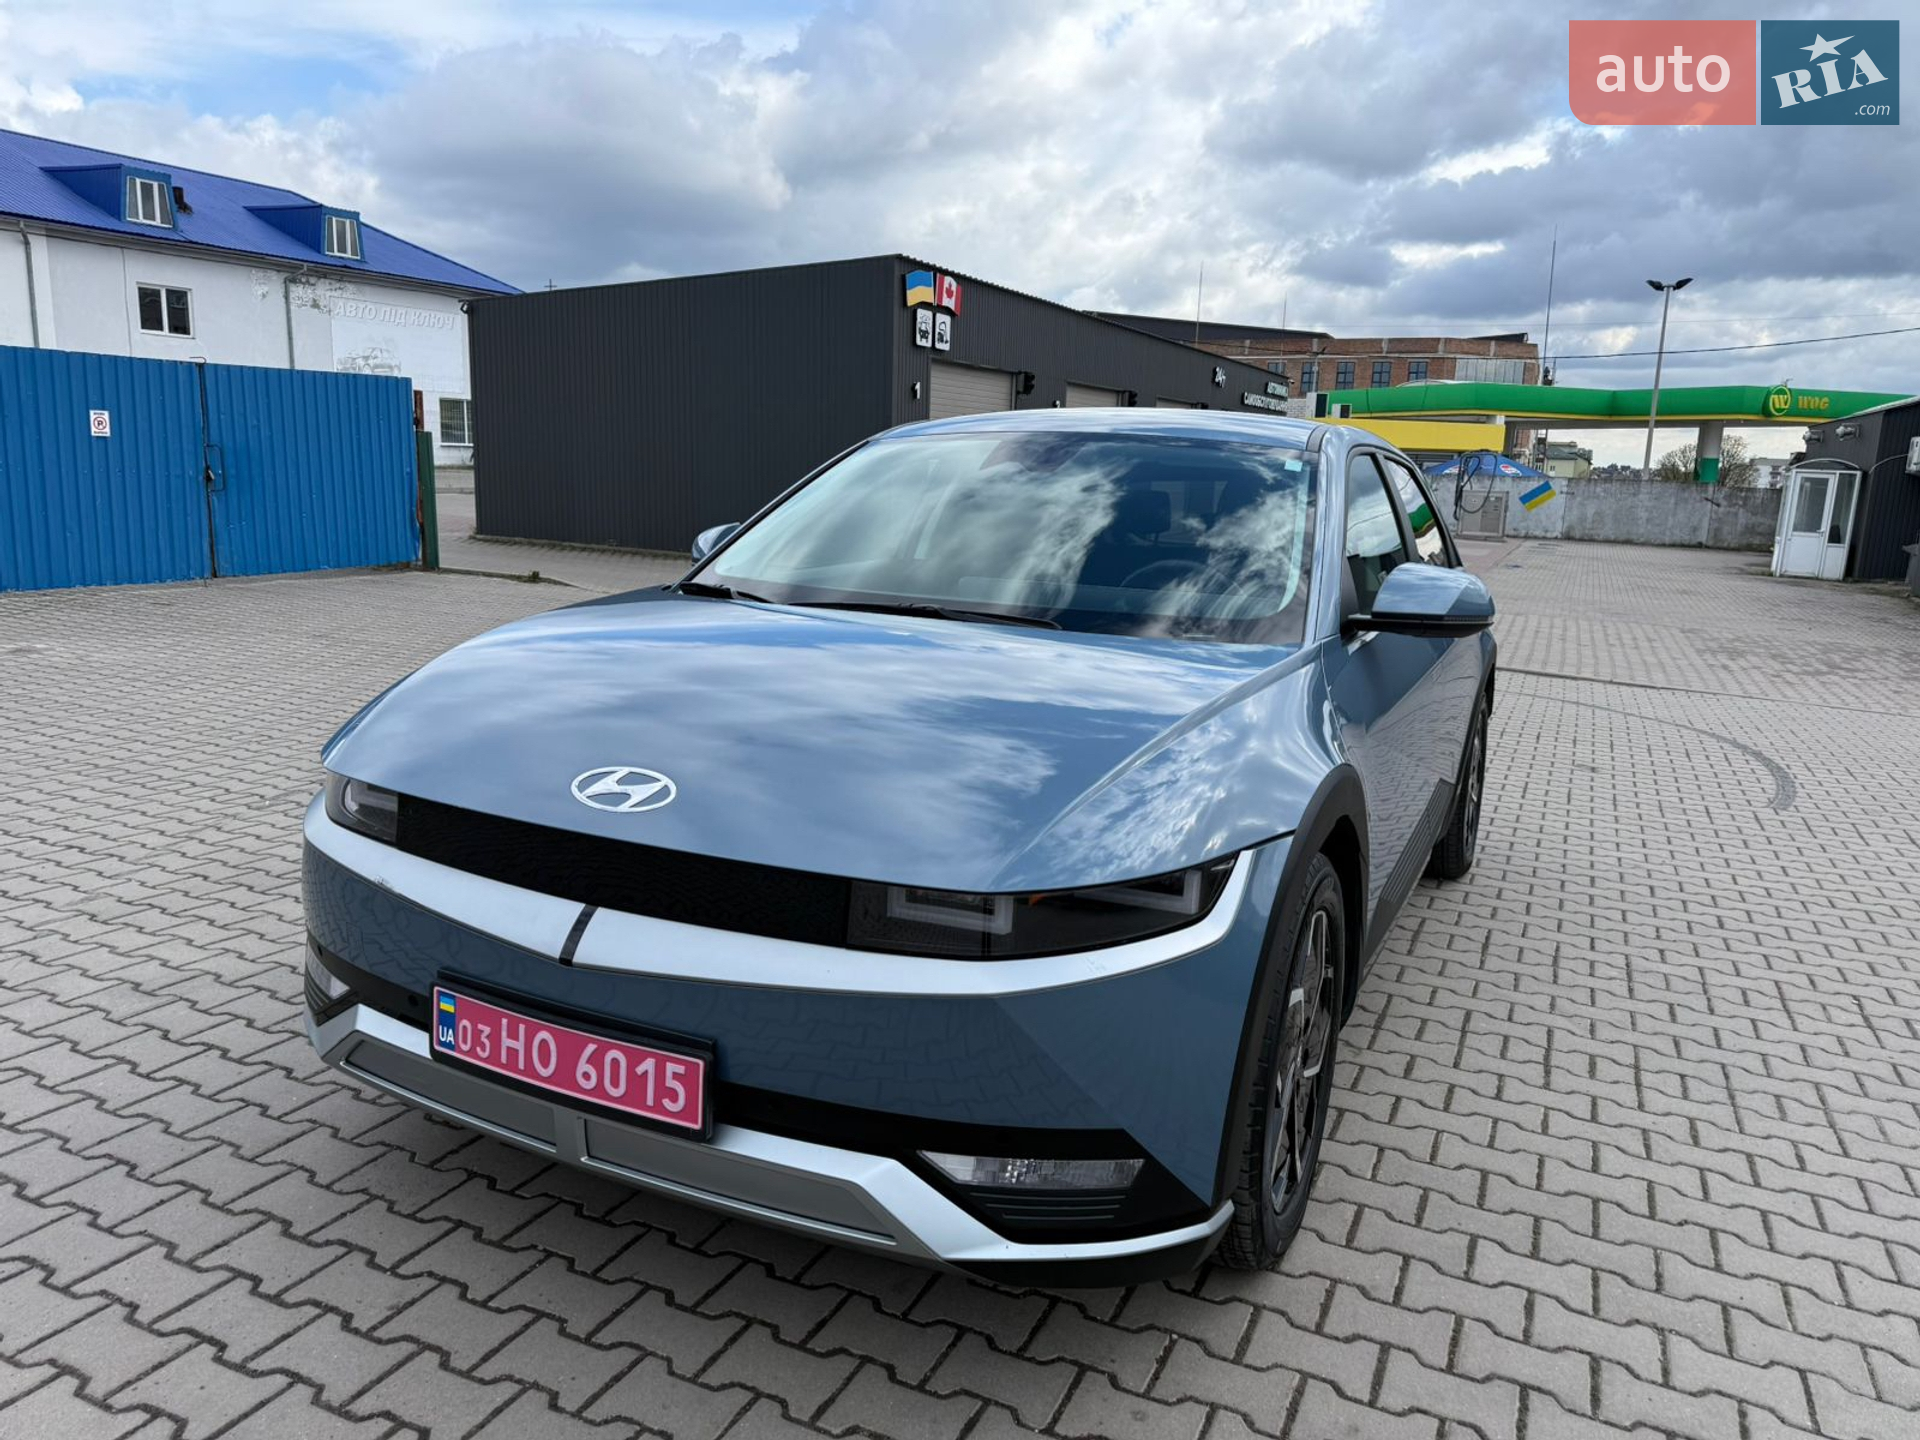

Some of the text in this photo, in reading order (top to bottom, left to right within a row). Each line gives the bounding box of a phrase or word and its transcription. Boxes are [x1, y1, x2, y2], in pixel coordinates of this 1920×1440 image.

[336, 302, 456, 330] АВТО ПІД КЛЮЧ
[915, 381, 921, 400] 1
[1797, 395, 1830, 410] WOG
[438, 1025, 455, 1046] UA
[458, 1017, 687, 1113] 03 HO 6015
